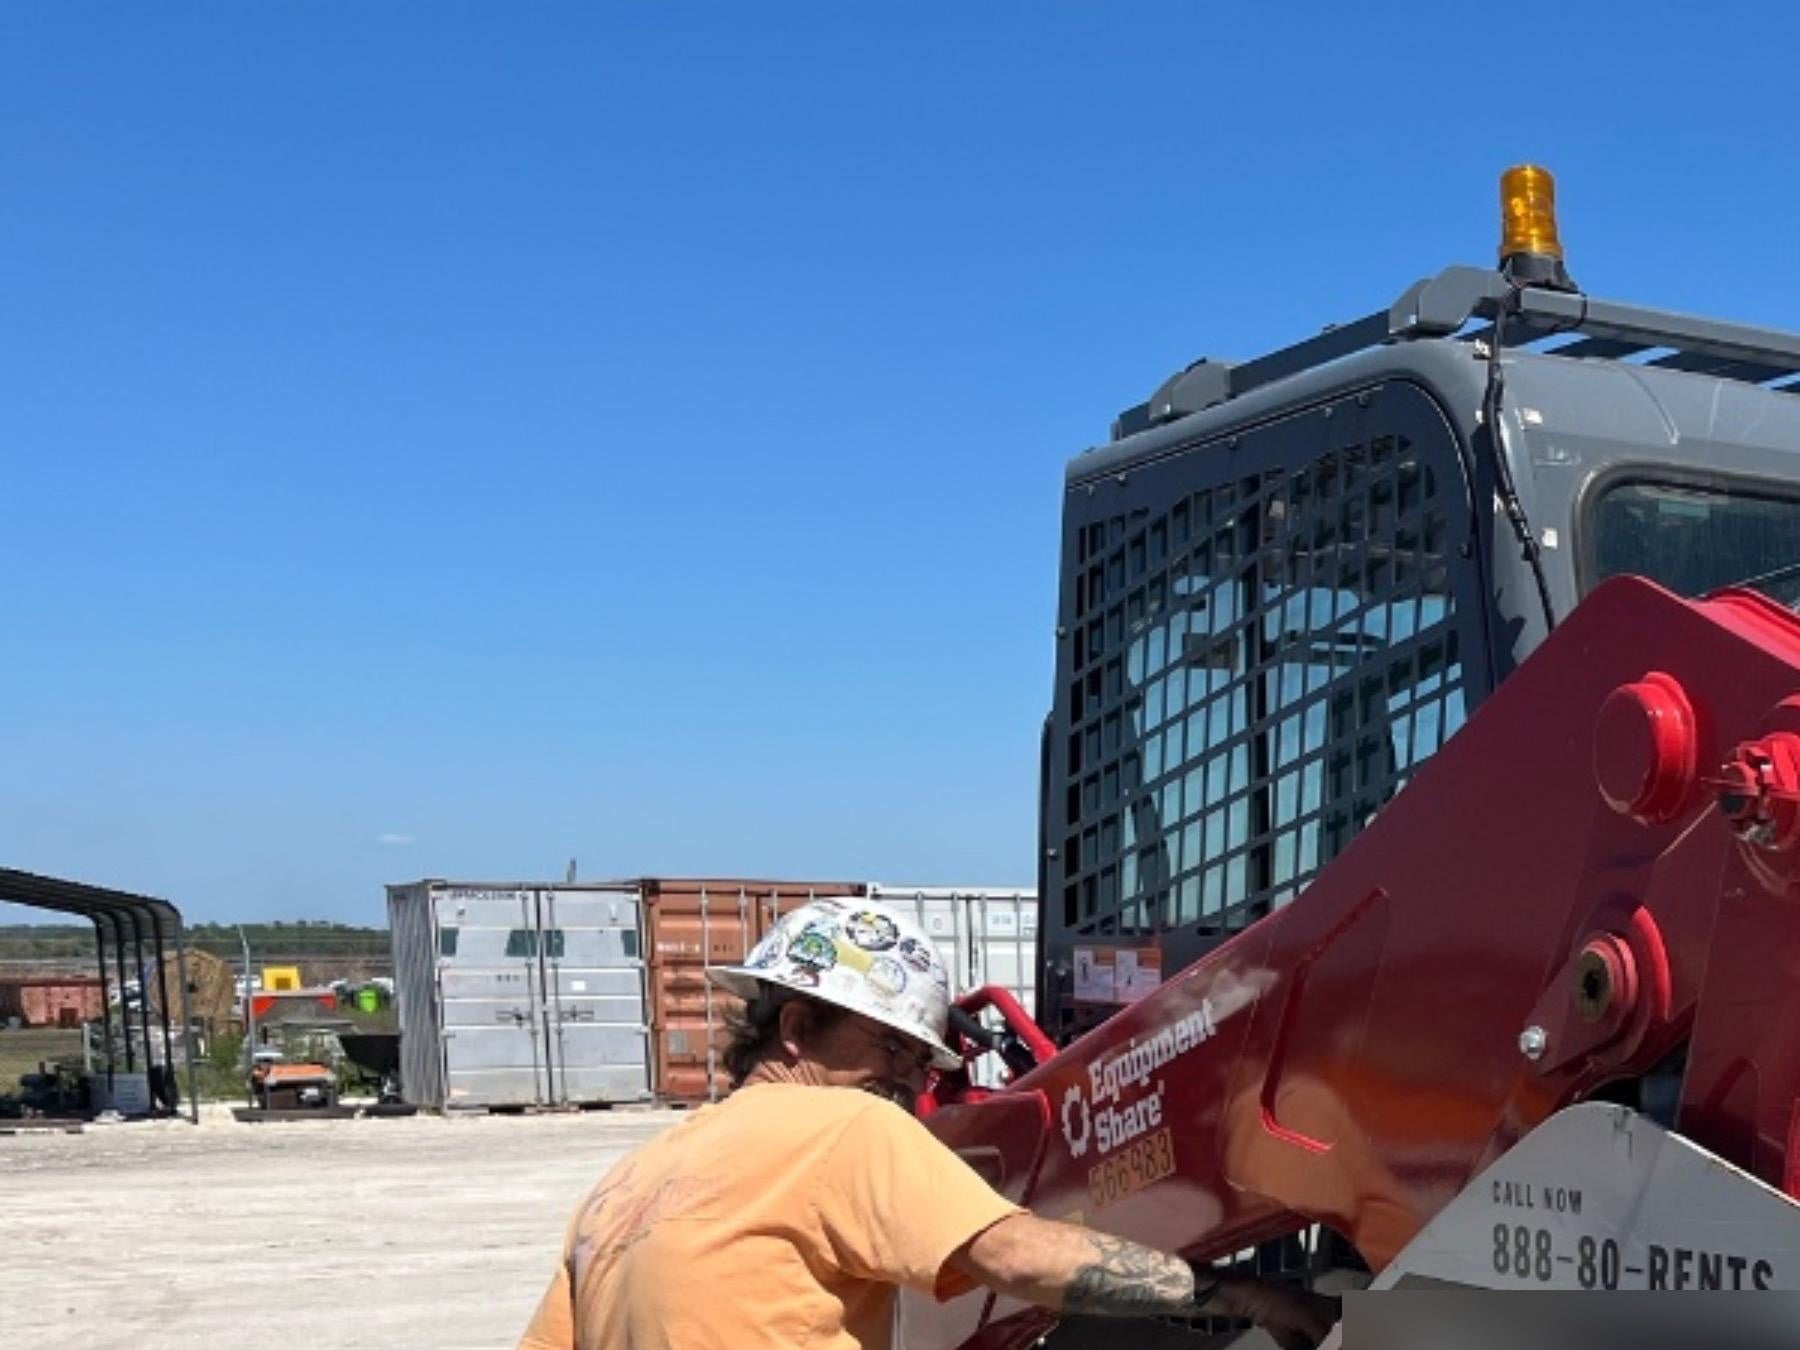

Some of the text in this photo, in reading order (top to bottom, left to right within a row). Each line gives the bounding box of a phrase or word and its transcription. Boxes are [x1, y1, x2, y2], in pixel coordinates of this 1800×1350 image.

[1089, 998, 1216, 1105] Equipment
[1094, 1092, 1163, 1153] Share
[1493, 1180, 1582, 1215] CALL NOW
